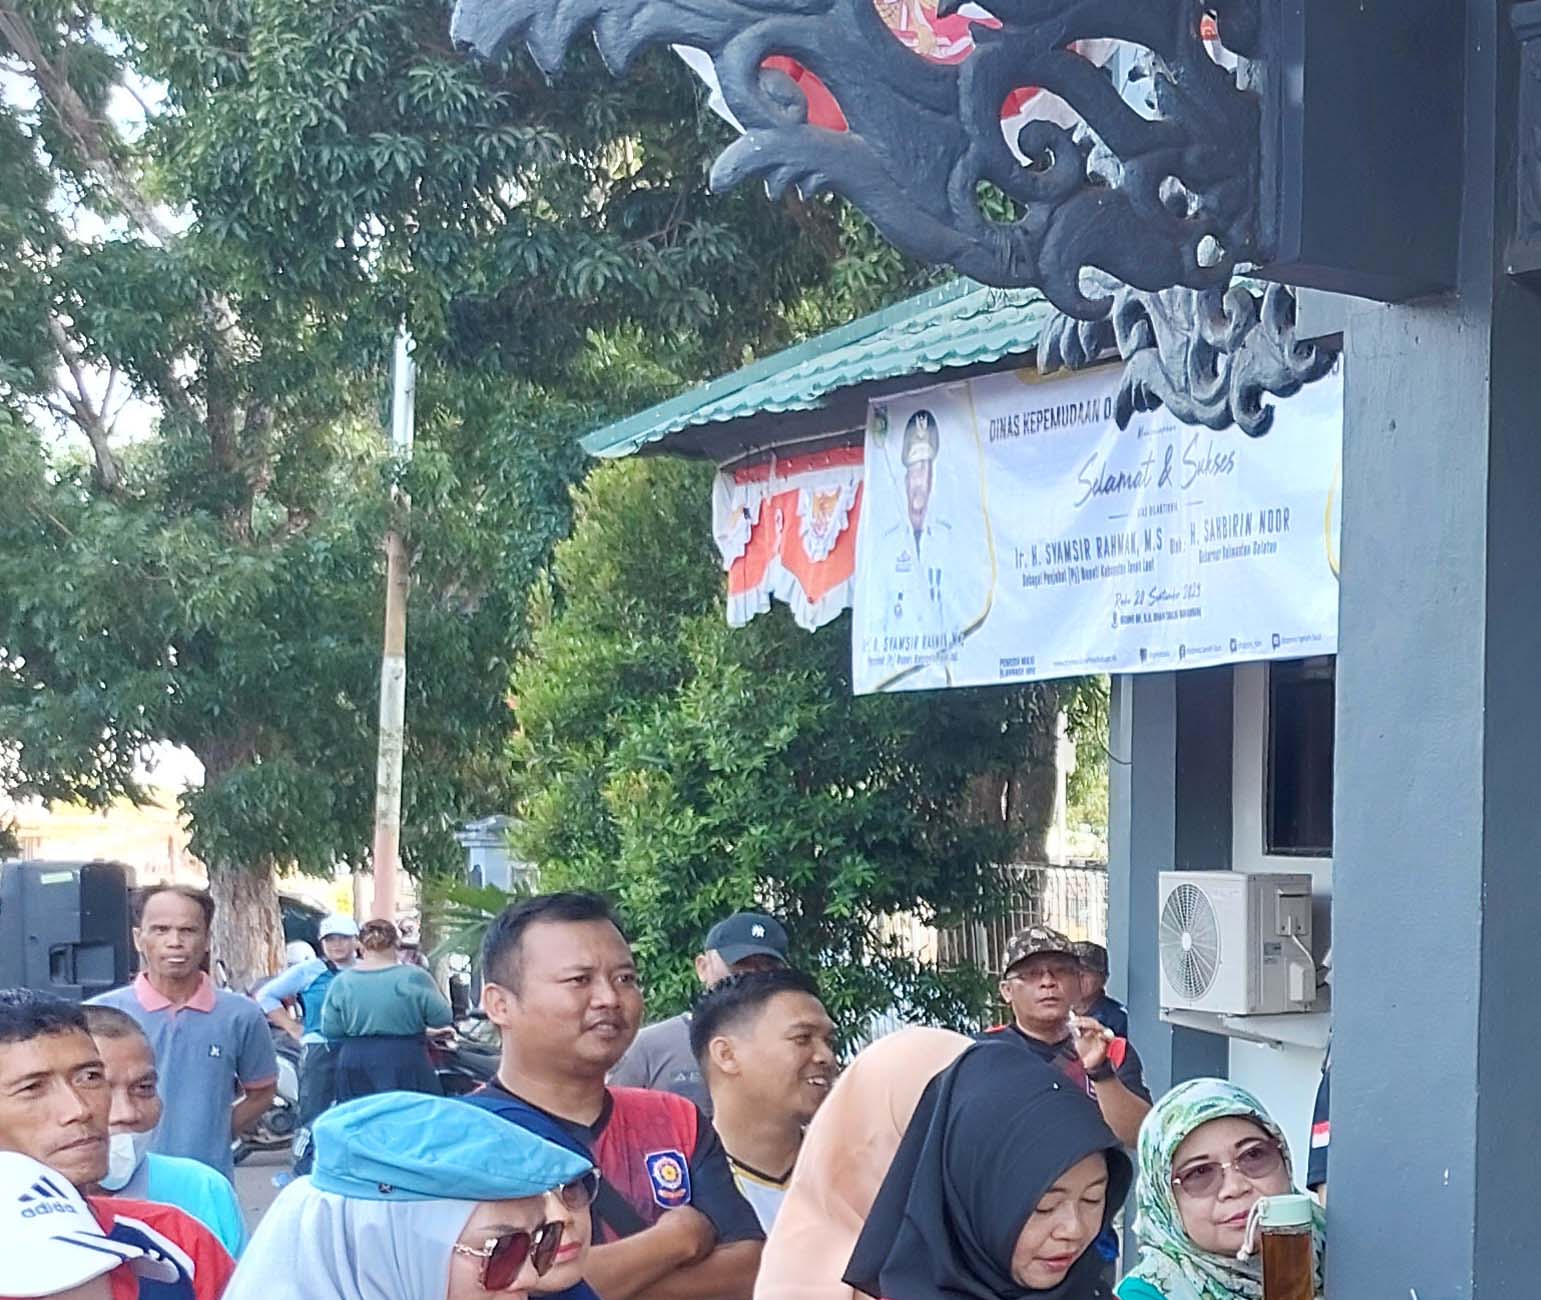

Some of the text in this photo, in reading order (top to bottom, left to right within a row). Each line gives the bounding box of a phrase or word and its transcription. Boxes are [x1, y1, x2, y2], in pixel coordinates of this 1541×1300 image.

[989, 413, 1020, 442] DINAS
[1023, 399, 1100, 434] KEPEMUDAAN
[1073, 432, 1237, 508] Selamat & Sukses
[1259, 507, 1291, 534] NOOR
[1045, 537, 1092, 566] SYAMSIR
